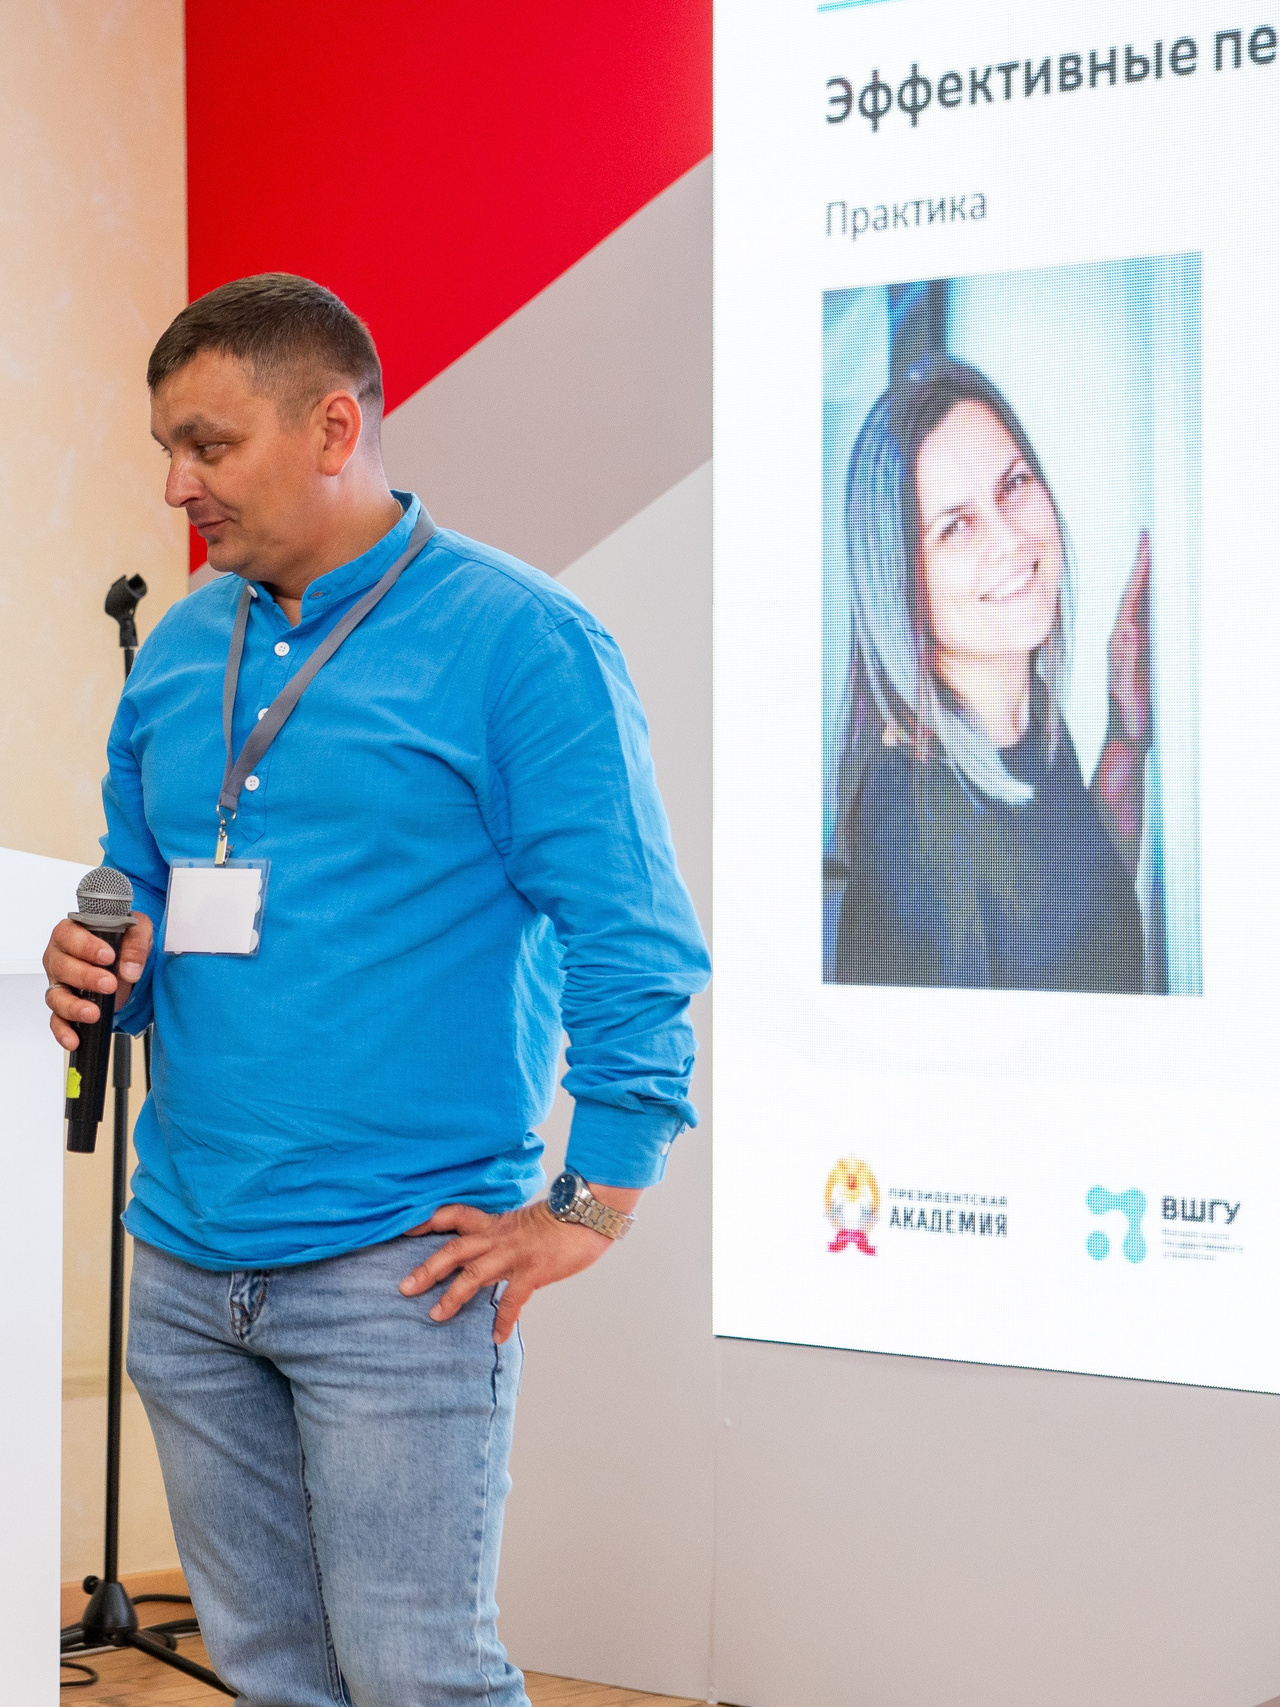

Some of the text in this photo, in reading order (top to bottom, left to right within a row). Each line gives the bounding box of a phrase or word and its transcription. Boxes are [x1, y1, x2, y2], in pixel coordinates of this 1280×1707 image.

[826, 24, 1278, 133] Эффективные пе
[826, 192, 987, 241] Практика
[888, 1206, 1007, 1237] АКАДЕМИЯ
[1161, 1196, 1241, 1225] ВШГУ
